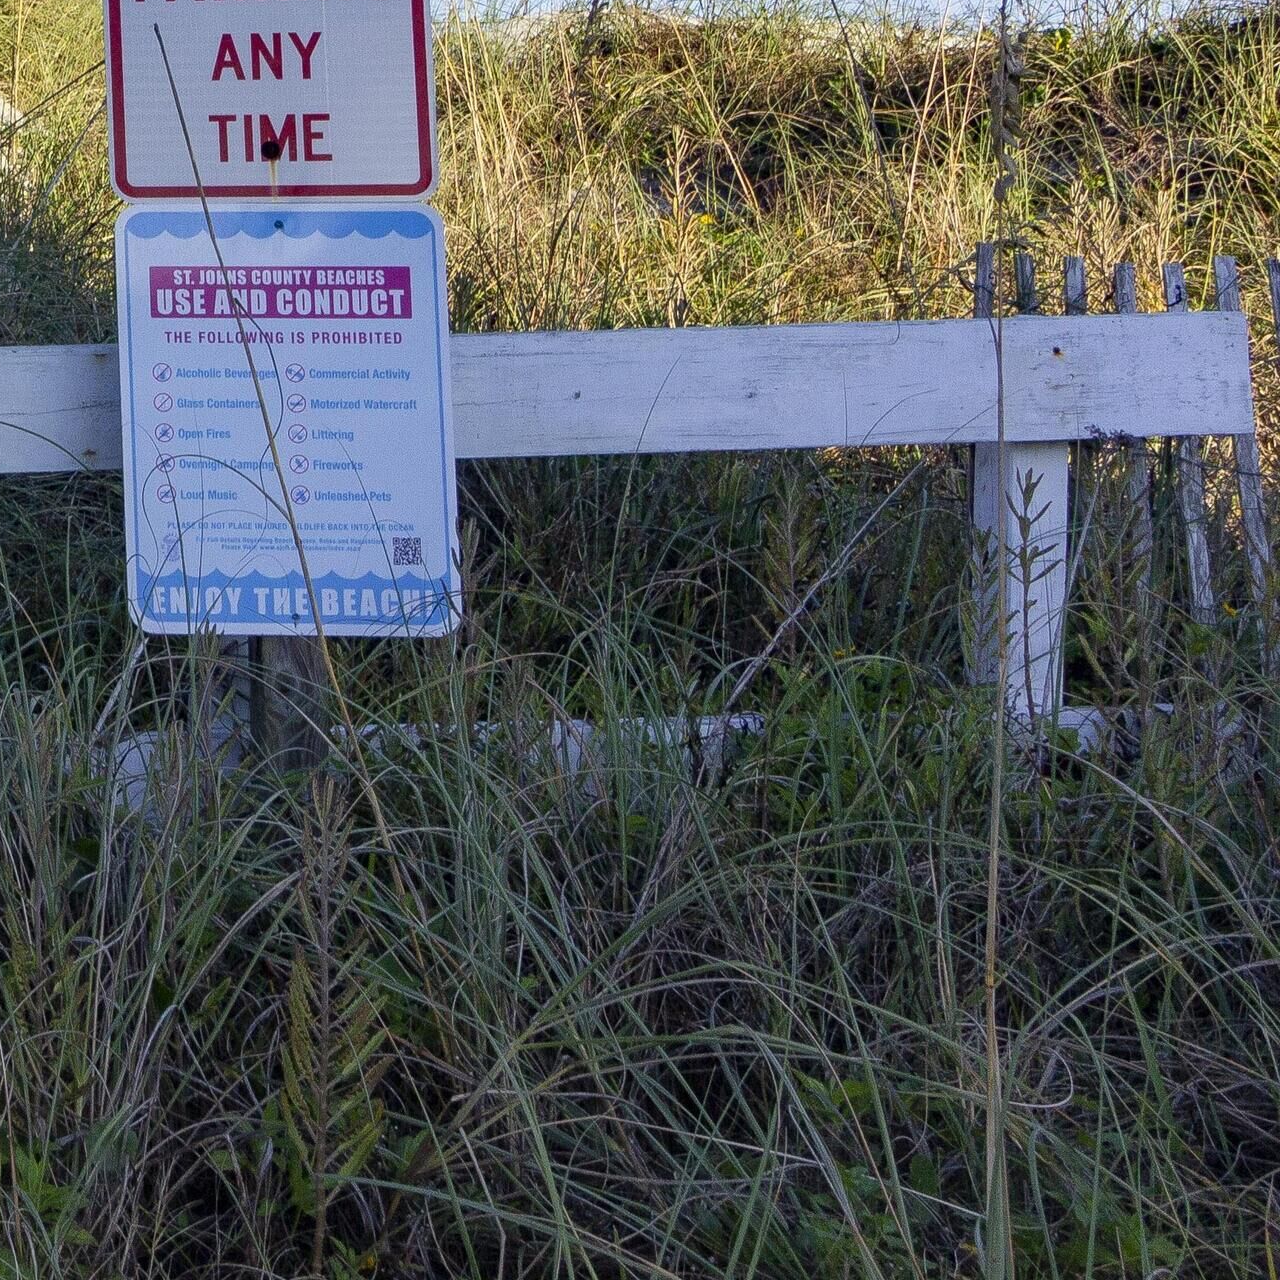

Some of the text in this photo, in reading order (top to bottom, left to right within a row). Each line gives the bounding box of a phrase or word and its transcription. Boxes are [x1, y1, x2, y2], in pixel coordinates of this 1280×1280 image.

[211, 32, 322, 81] ANY
[208, 113, 333, 163] TIME
[173, 269, 386, 285] ST. JOHNS COUNTY BEACHES
[156, 288, 405, 315] USE AND CONDUCT
[164, 331, 402, 344] THE FOLLOWING IS PROHIBITED
[176, 368, 277, 381] Alcoholic Beverges
[309, 368, 411, 381] Commercial Activity
[176, 398, 261, 409] Glass Containers
[310, 399, 418, 410] Motorized Watercraft
[178, 428, 231, 441] Open Fires
[311, 429, 354, 442] Littering
[313, 460, 363, 471] Fireworks
[180, 490, 238, 500] Loud Music
[314, 491, 392, 502] Unleashed Pets
[211, 521, 226, 529] NOT
[228, 521, 253, 529] PLACE
[327, 522, 348, 531] BACK
[153, 586, 241, 615] ENJOY
[253, 587, 309, 616] THE
